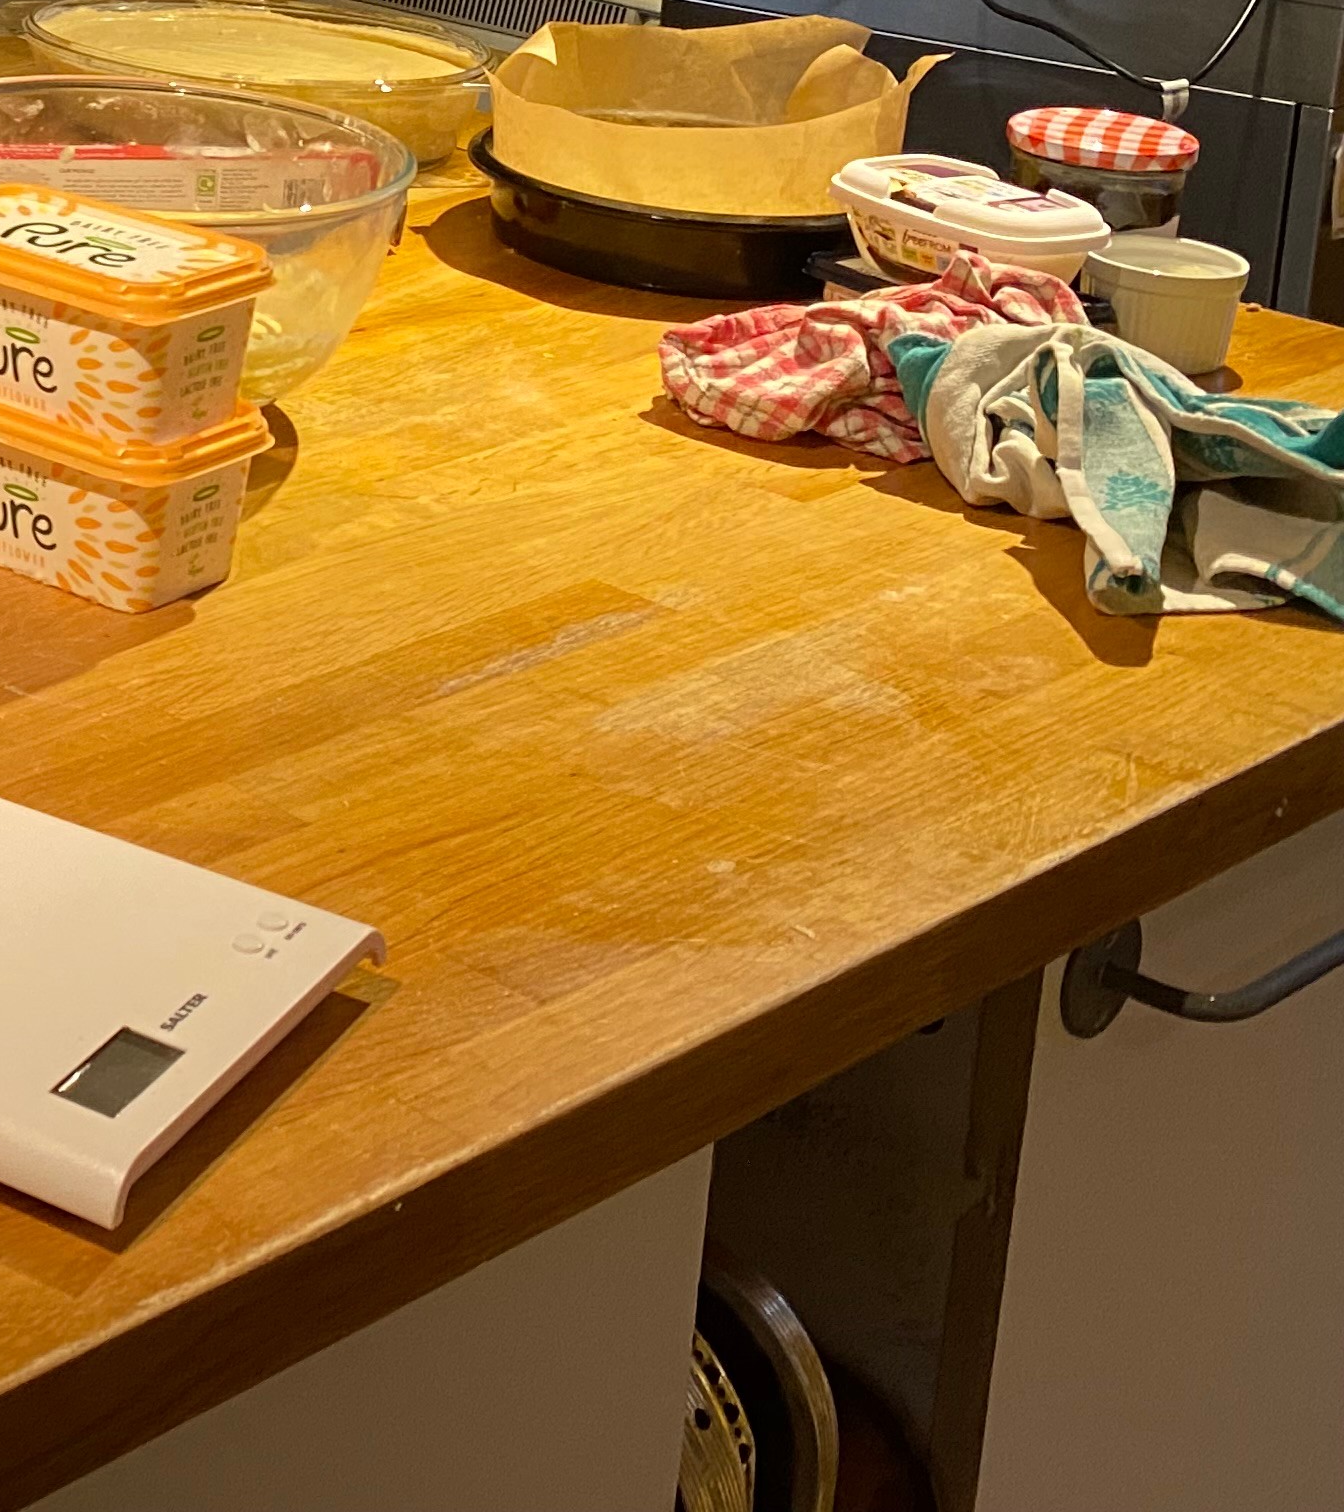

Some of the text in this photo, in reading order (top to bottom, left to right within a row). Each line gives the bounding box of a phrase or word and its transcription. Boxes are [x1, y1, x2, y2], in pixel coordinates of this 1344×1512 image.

[0, 221, 137, 268] Pure
[68, 219, 126, 238] DAIRY
[160, 991, 208, 1033] SALTER
